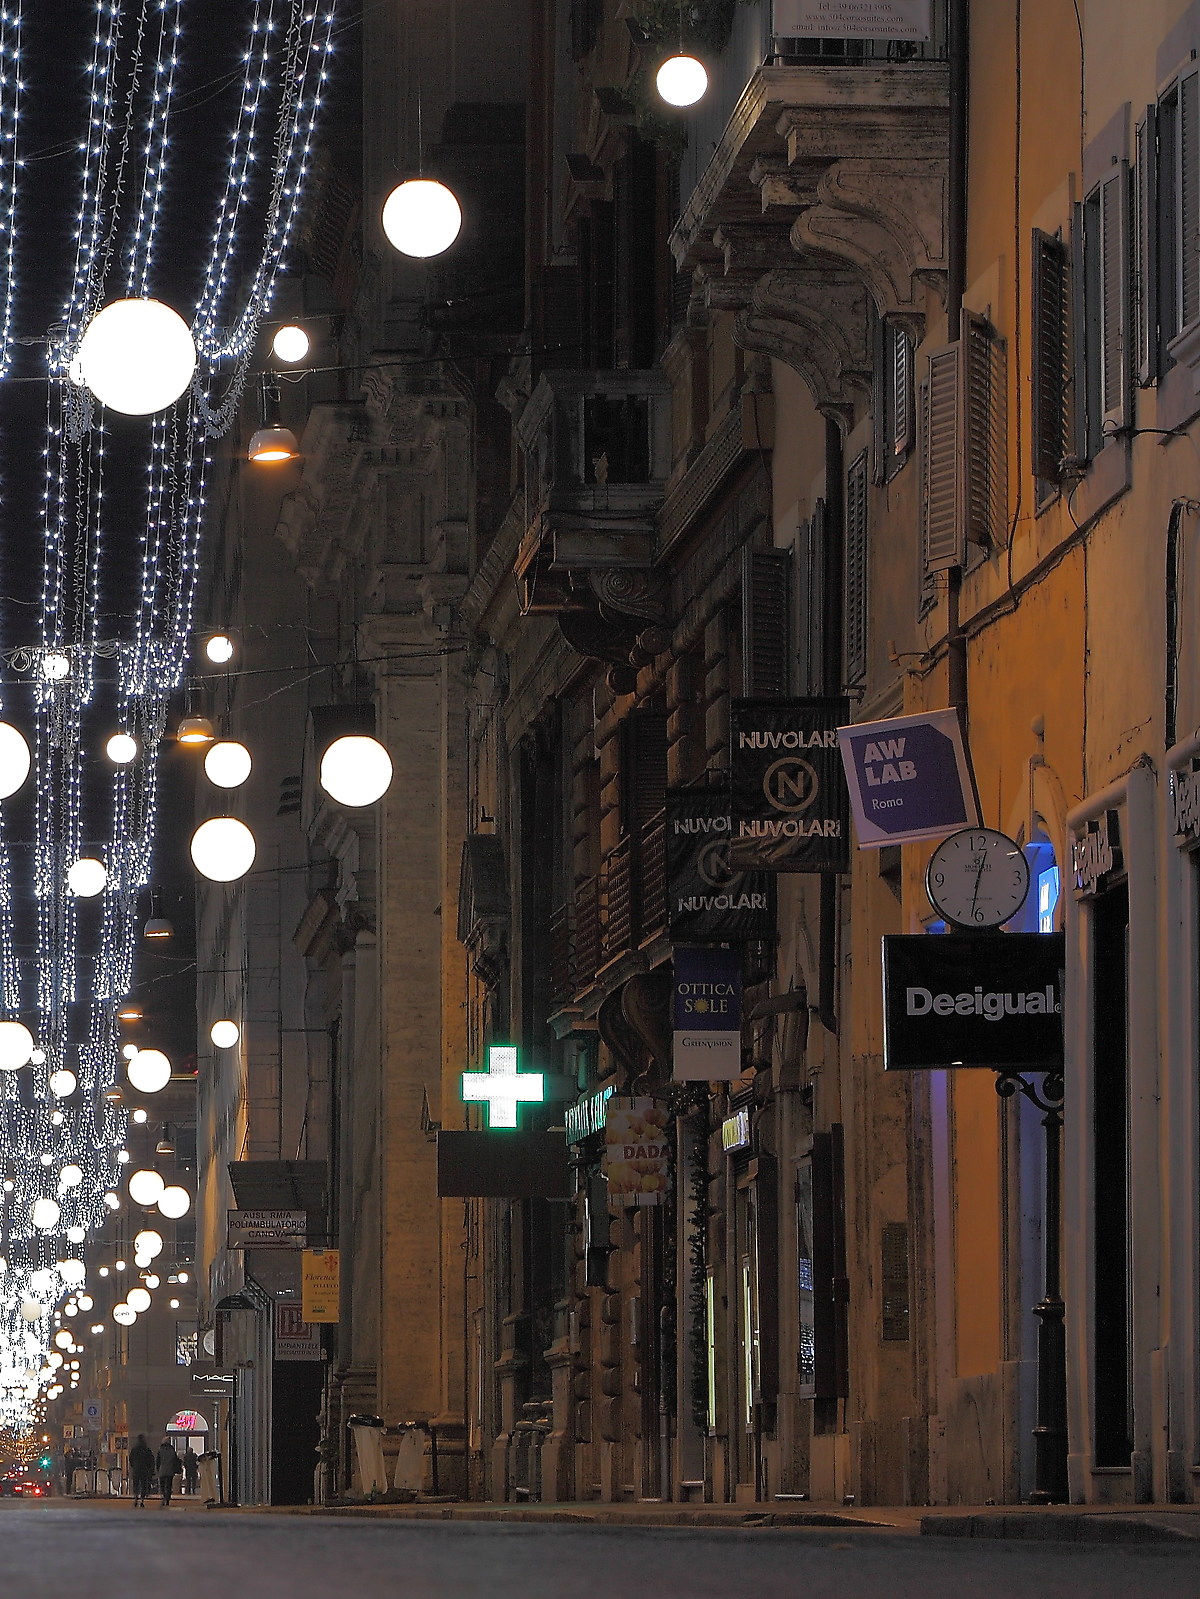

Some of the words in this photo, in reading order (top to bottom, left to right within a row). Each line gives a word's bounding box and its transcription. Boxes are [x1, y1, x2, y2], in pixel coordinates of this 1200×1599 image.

[863, 738, 907, 763] AW
[864, 760, 918, 787] LAB
[872, 798, 904, 810] Roma
[739, 819, 841, 838] NUVOLARI
[969, 835, 987, 851] 12
[935, 872, 945, 888] 9
[1013, 870, 1022, 886] 3
[678, 892, 768, 913] NUVOLARI
[974, 907, 984, 922] 6
[678, 983, 735, 996] OTTICA
[623, 1145, 672, 1159] DADA
[243, 1211, 266, 1219] AUSL
[230, 1220, 306, 1229] POLIAMBULATORIO
